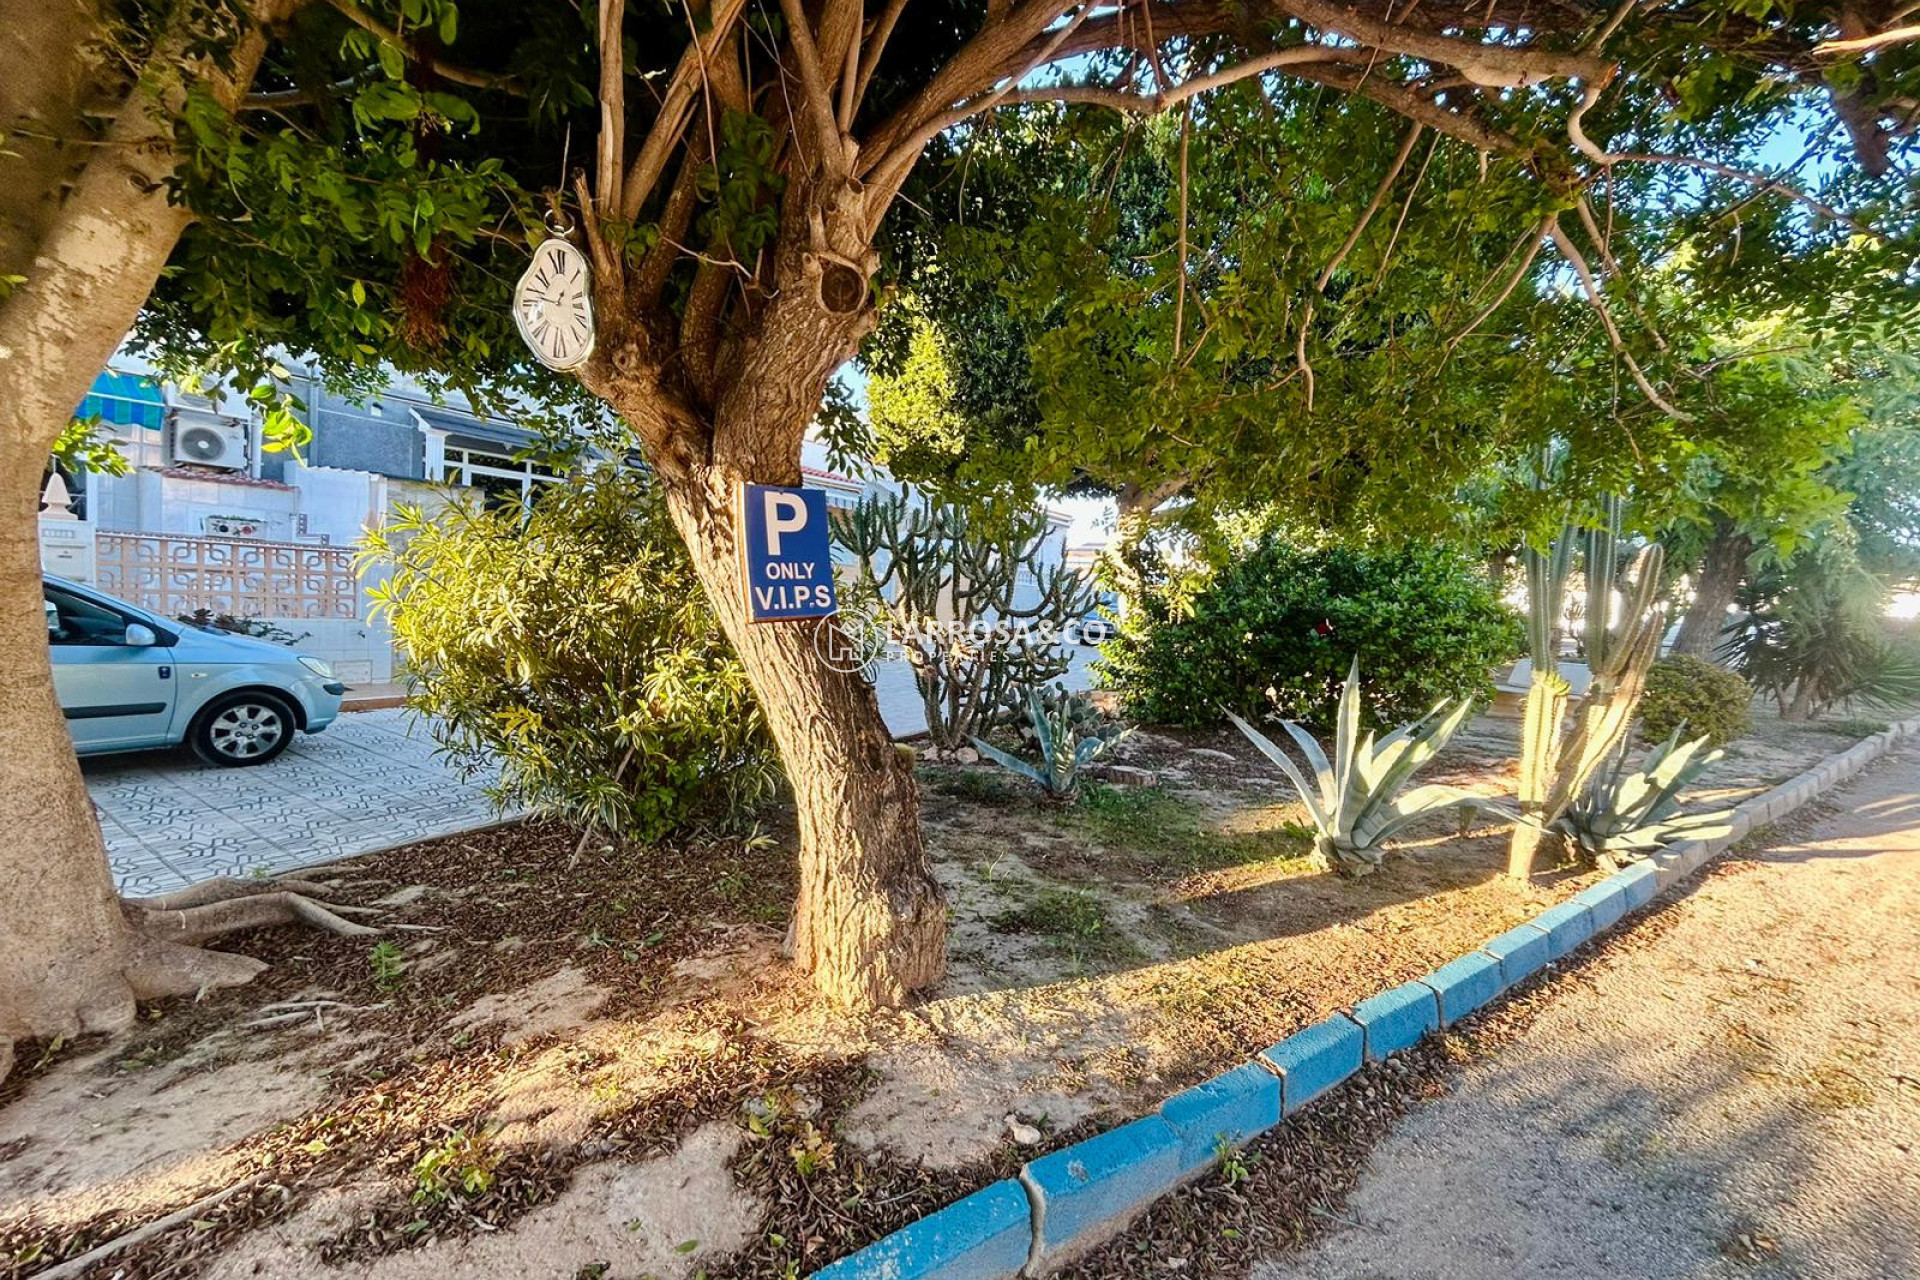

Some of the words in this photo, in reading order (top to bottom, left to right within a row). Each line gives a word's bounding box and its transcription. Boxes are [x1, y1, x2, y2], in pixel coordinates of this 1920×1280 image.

[764, 491, 807, 556] P
[766, 562, 815, 579] ONLY
[755, 585, 831, 610] V.I.P.S
